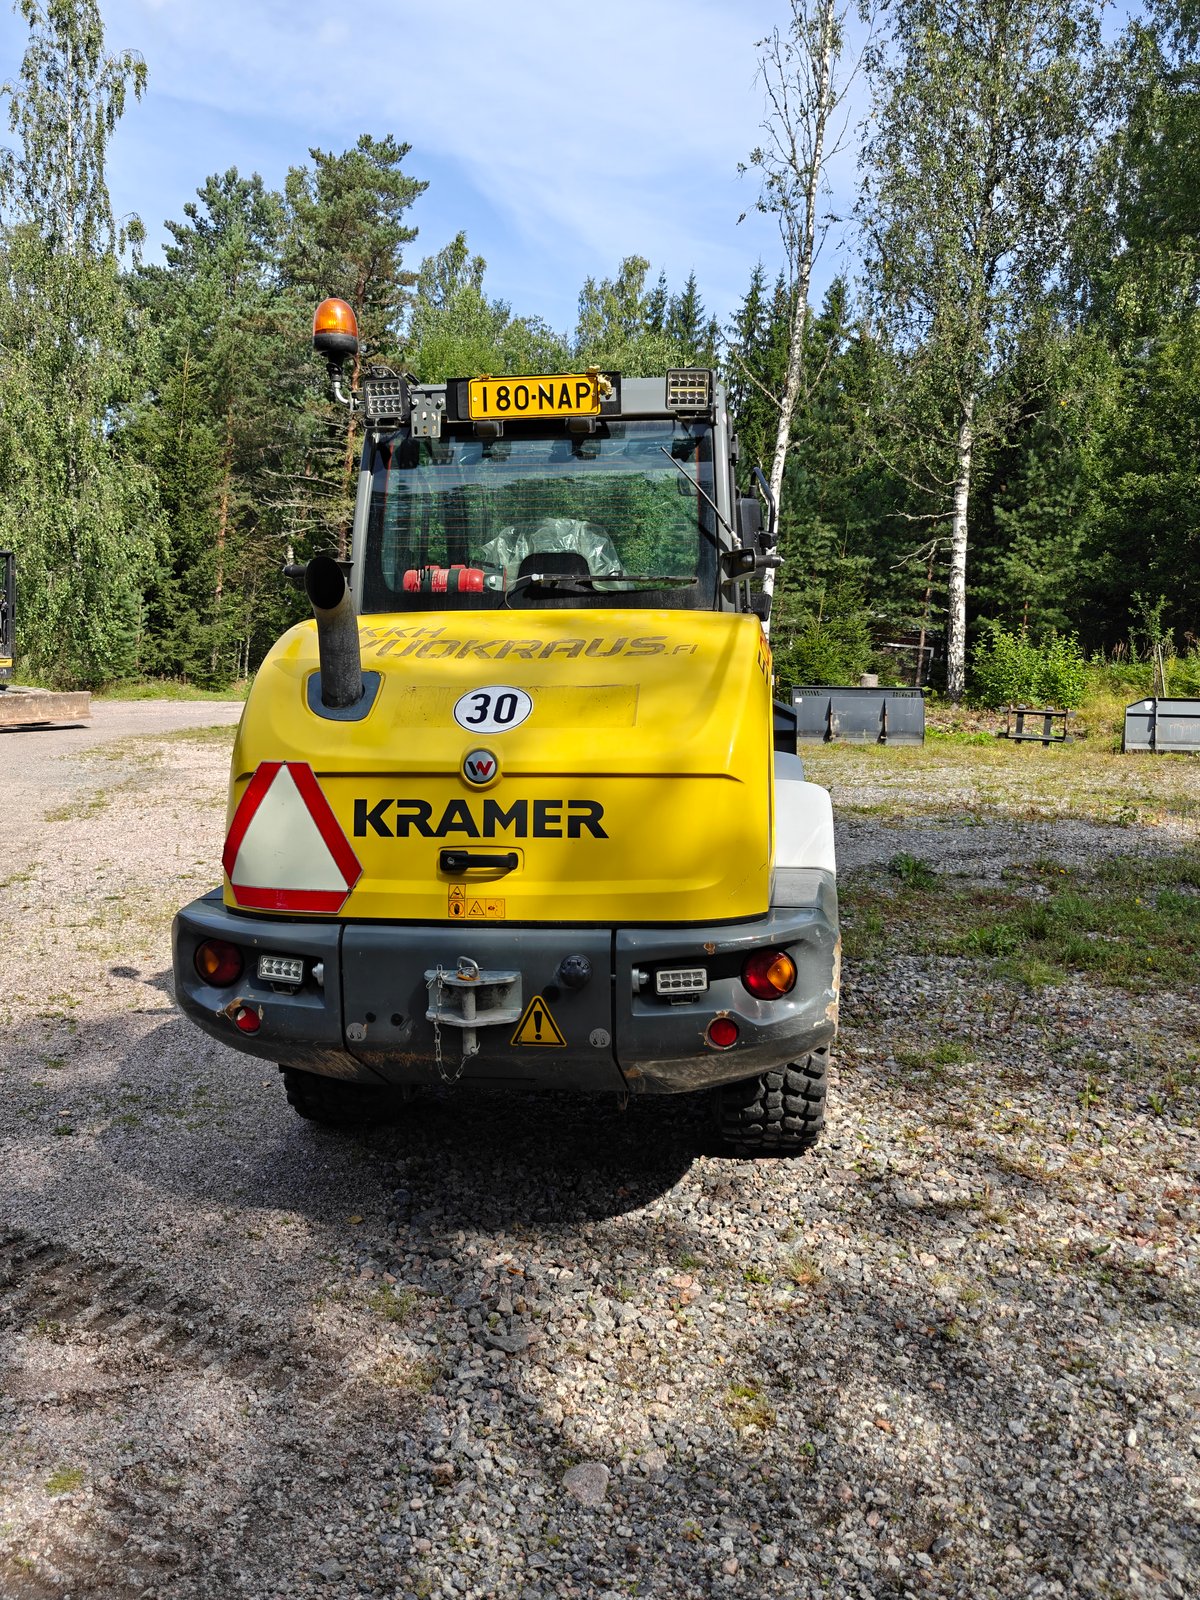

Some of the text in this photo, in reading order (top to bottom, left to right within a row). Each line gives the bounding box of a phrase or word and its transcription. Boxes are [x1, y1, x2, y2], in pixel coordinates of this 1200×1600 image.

[482, 382, 591, 412] 180-NAP
[465, 693, 519, 724] 30
[353, 799, 609, 839] KRAMER
